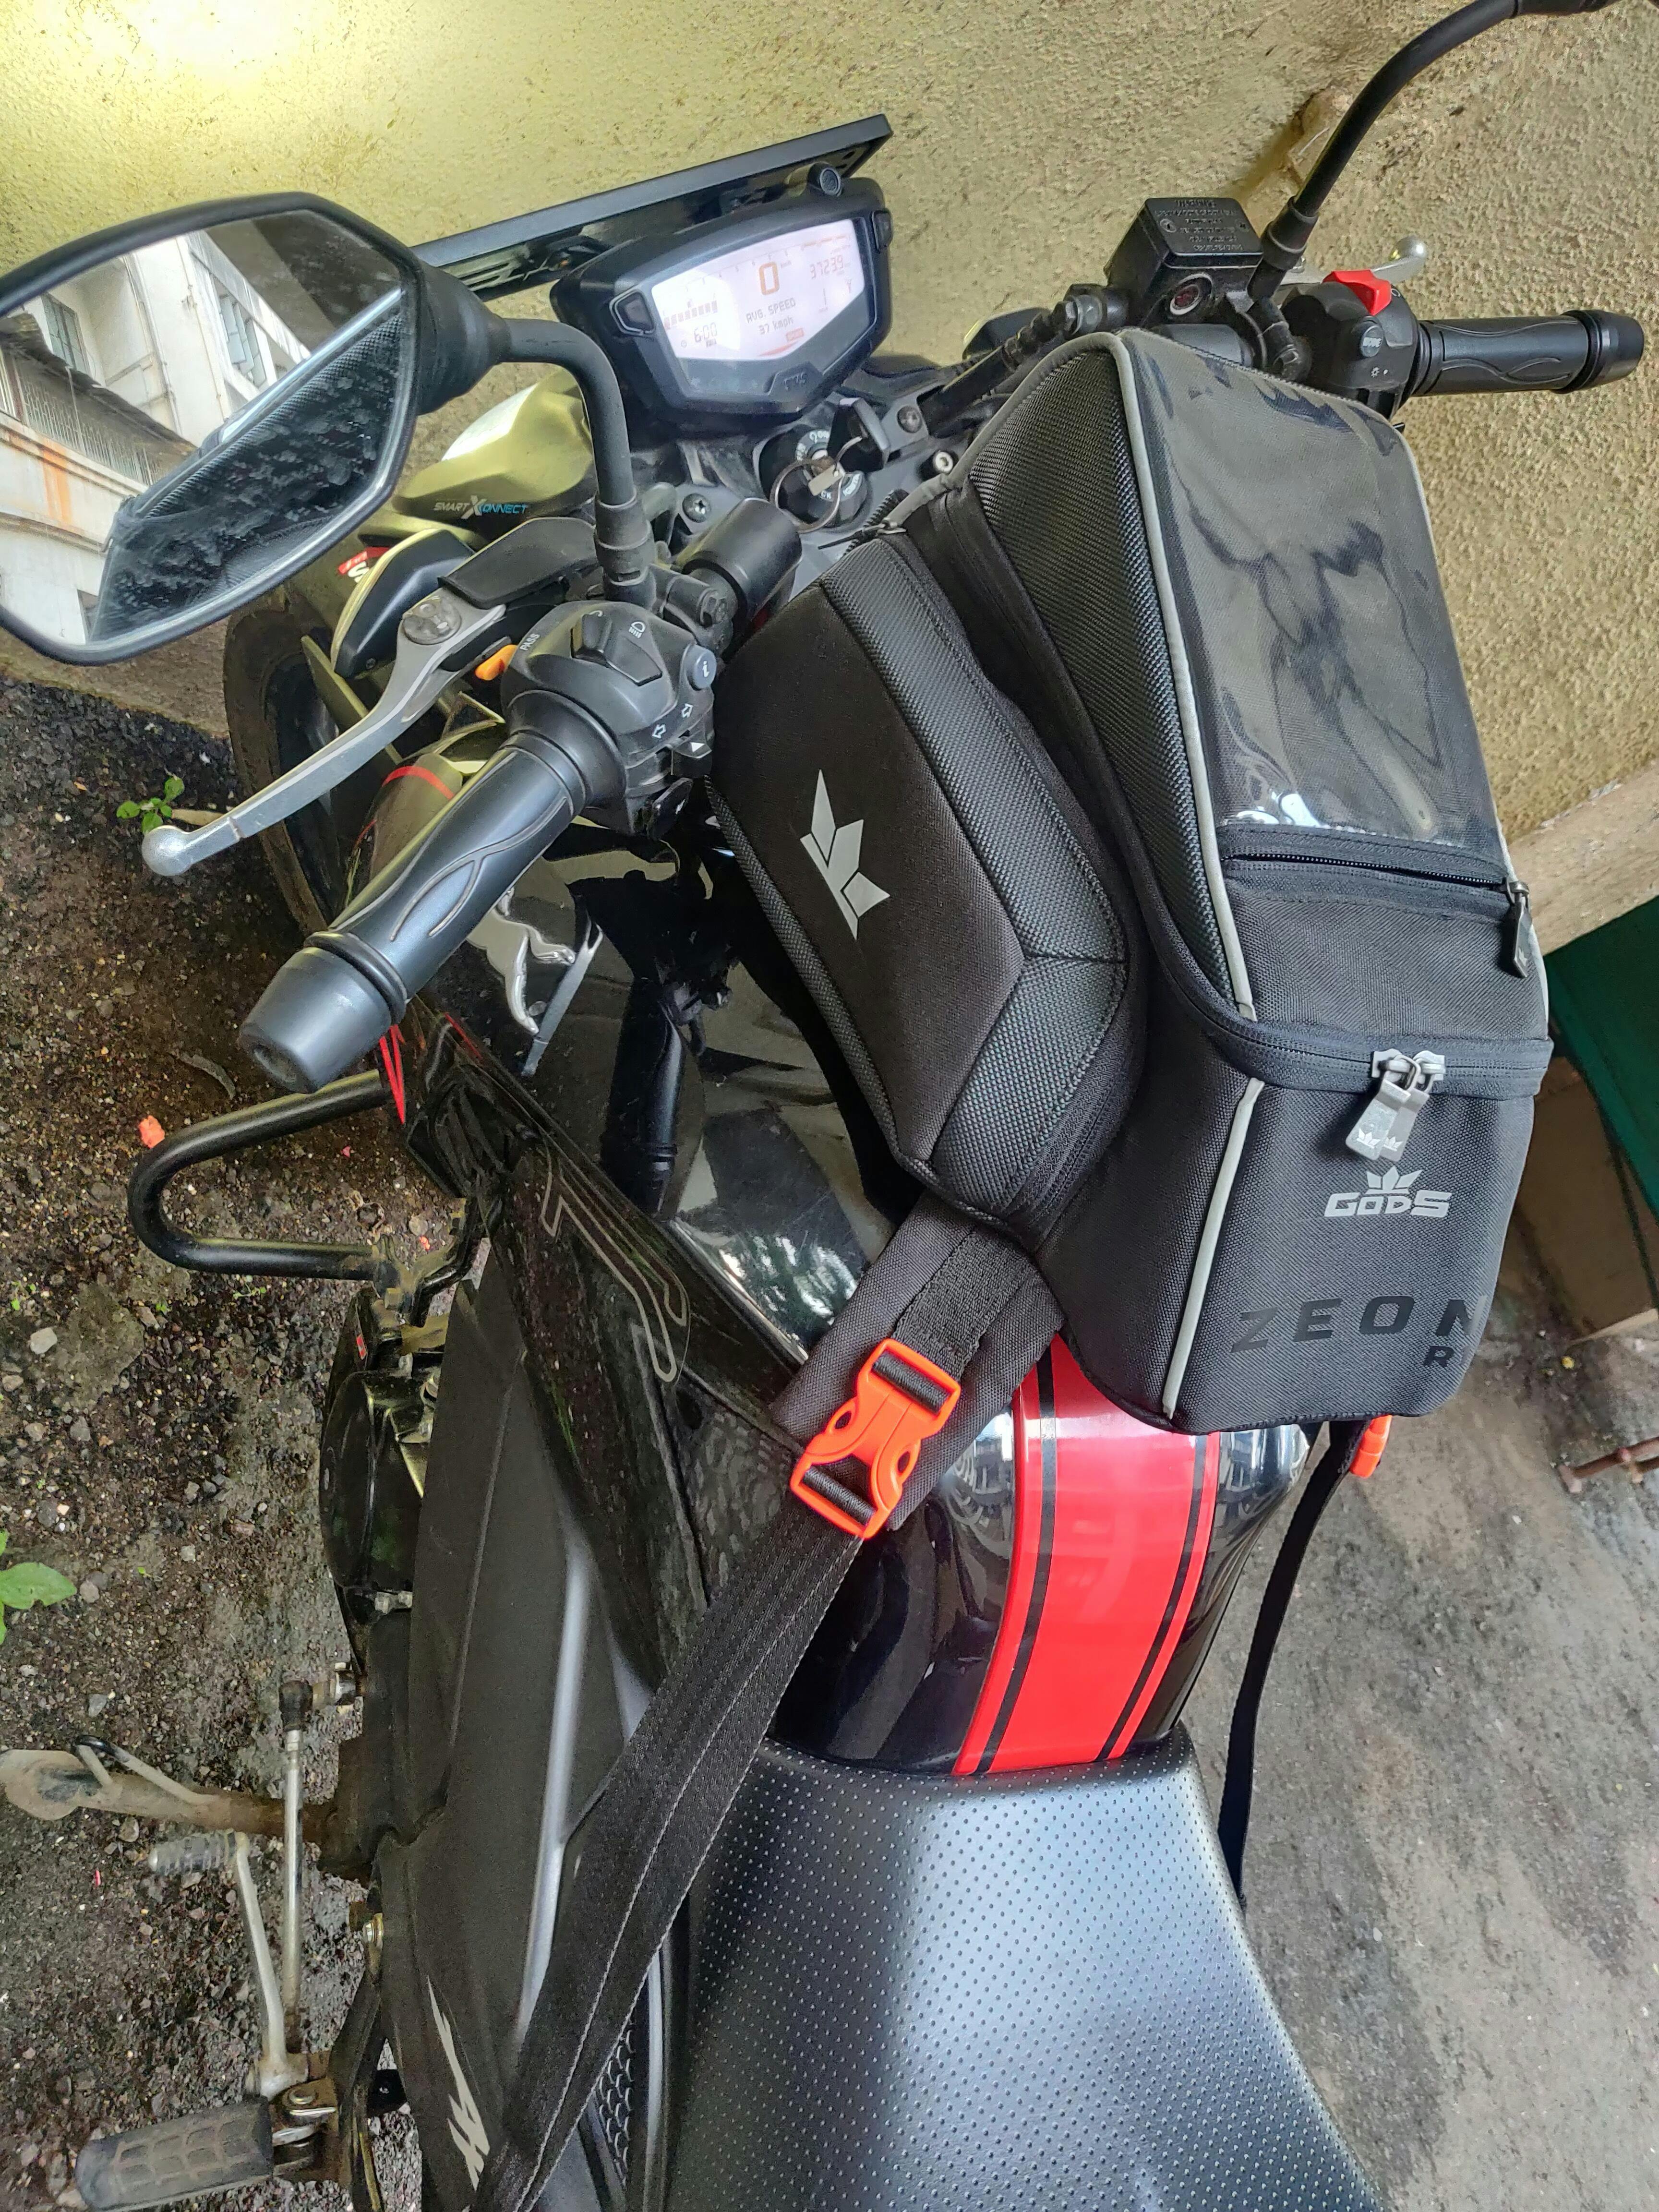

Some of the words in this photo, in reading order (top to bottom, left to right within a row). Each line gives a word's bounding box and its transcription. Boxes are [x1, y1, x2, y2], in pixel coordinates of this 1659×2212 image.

[810, 254, 844, 279] 37239
[746, 309, 766, 324] AVG.
[768, 298, 796, 315] SPEED
[772, 316, 794, 330] kmph
[519, 634, 540, 650] PASS
[1324, 1190, 1452, 1217] GODS
[1231, 1296, 1488, 1353] ZEON
